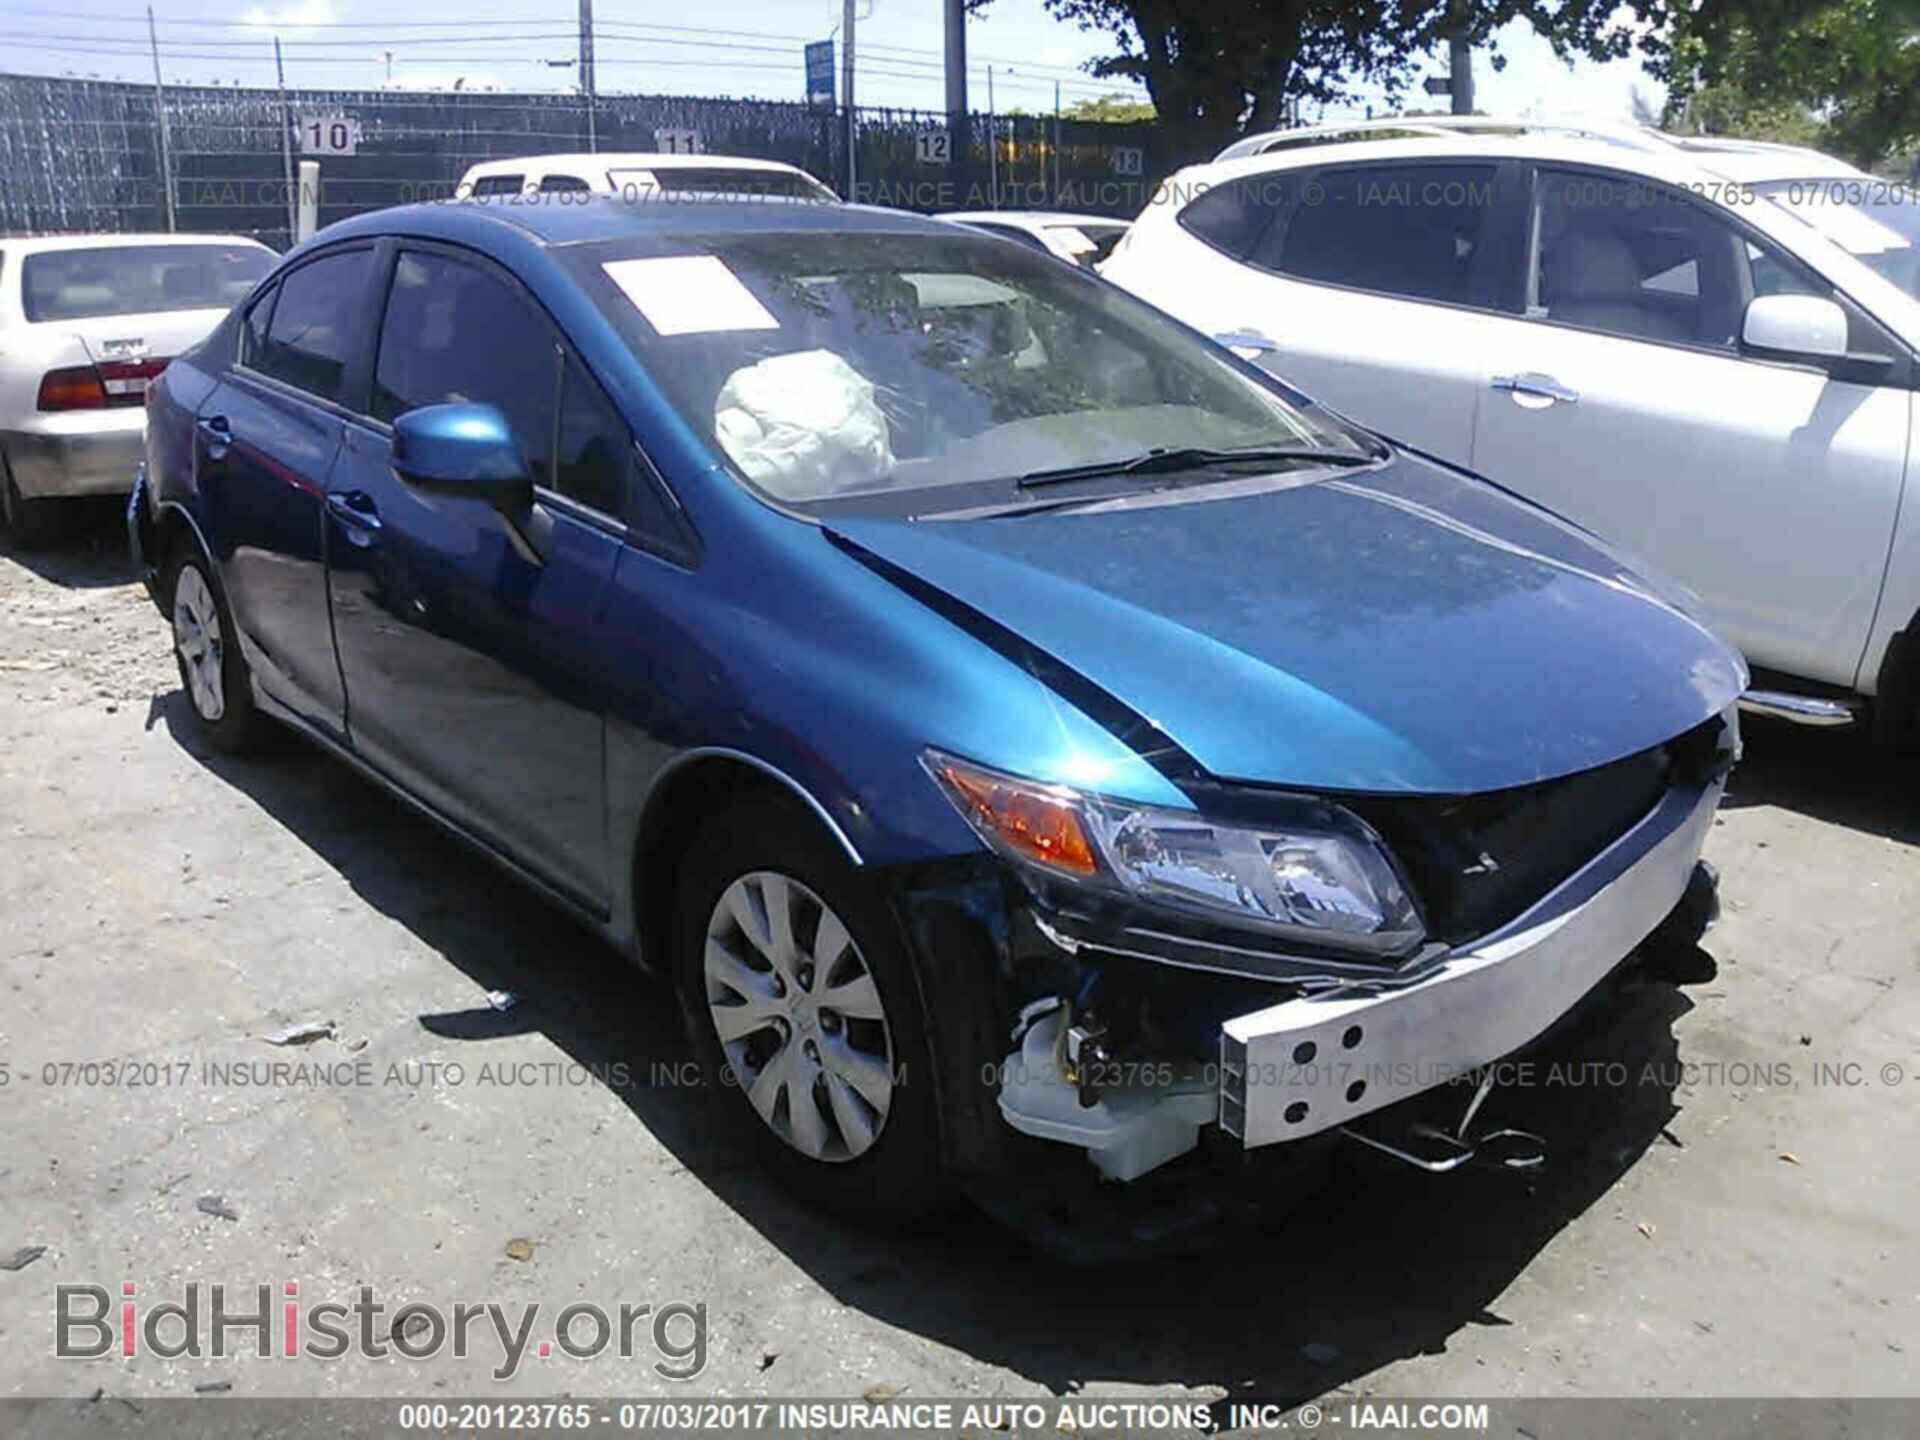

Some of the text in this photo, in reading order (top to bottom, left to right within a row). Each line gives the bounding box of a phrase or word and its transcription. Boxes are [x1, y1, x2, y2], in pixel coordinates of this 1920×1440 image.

[308, 123, 348, 150] 10
[665, 134, 694, 154] 11
[919, 136, 946, 158] 12
